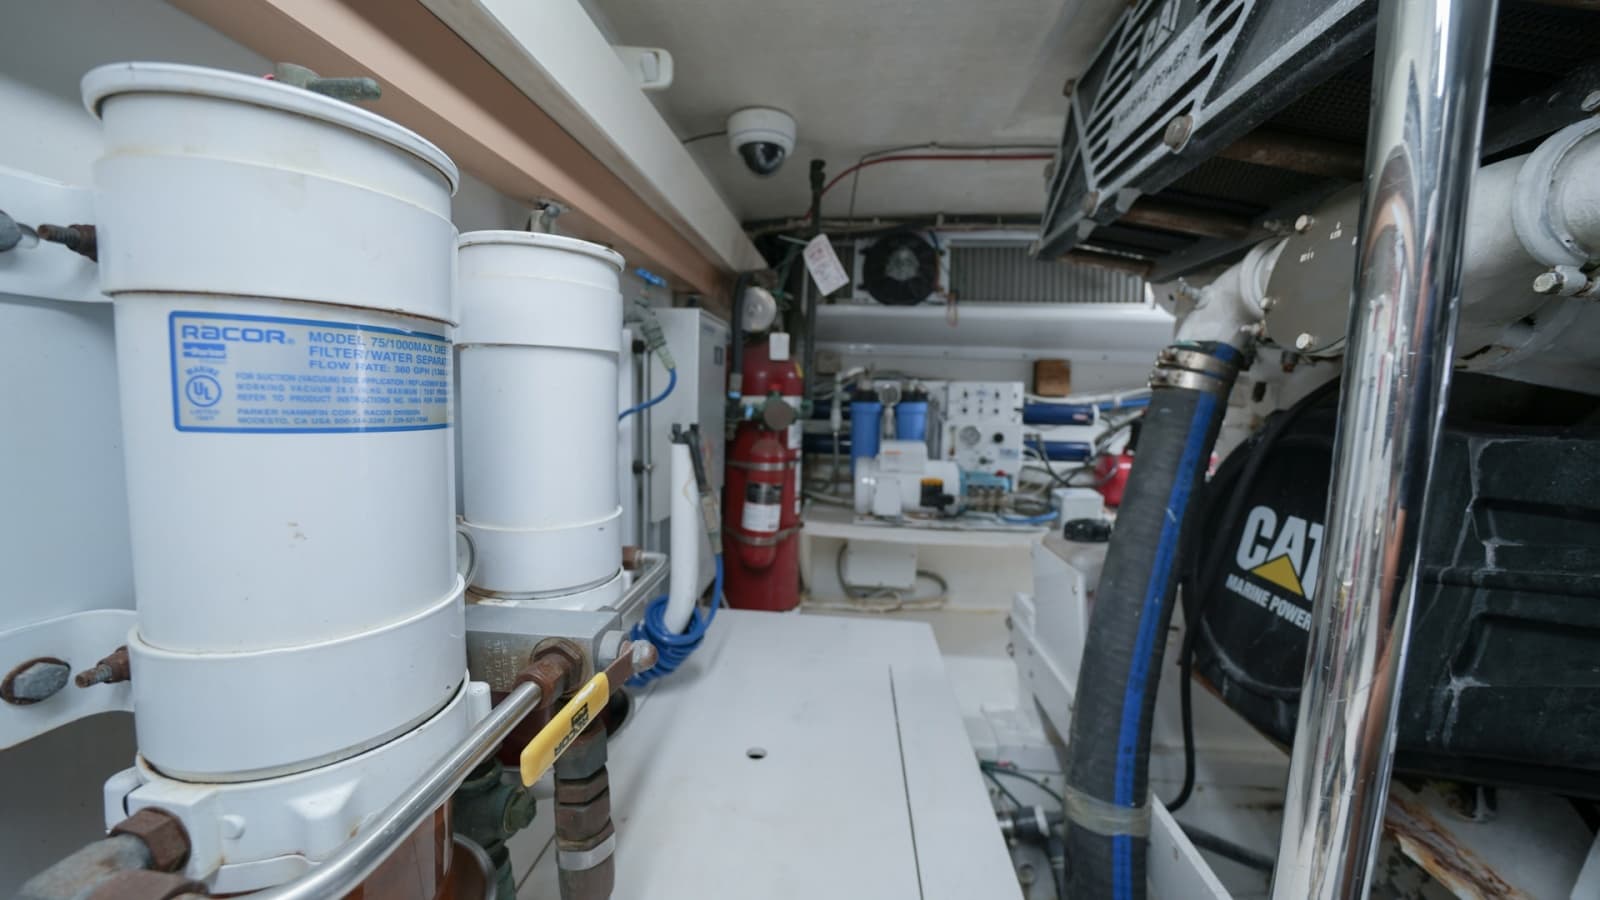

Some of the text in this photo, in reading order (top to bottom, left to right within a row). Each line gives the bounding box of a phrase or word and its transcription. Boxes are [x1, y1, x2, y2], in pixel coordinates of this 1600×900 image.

[308, 331, 366, 346] MODEL
[370, 336, 433, 353] 75/1000MAX
[308, 346, 413, 363] FILTER/WATER
[308, 359, 351, 370] FLOW
[193, 381, 213, 401] UL
[1235, 504, 1324, 601] CAT
[1225, 572, 1312, 632] MARINE POWER
